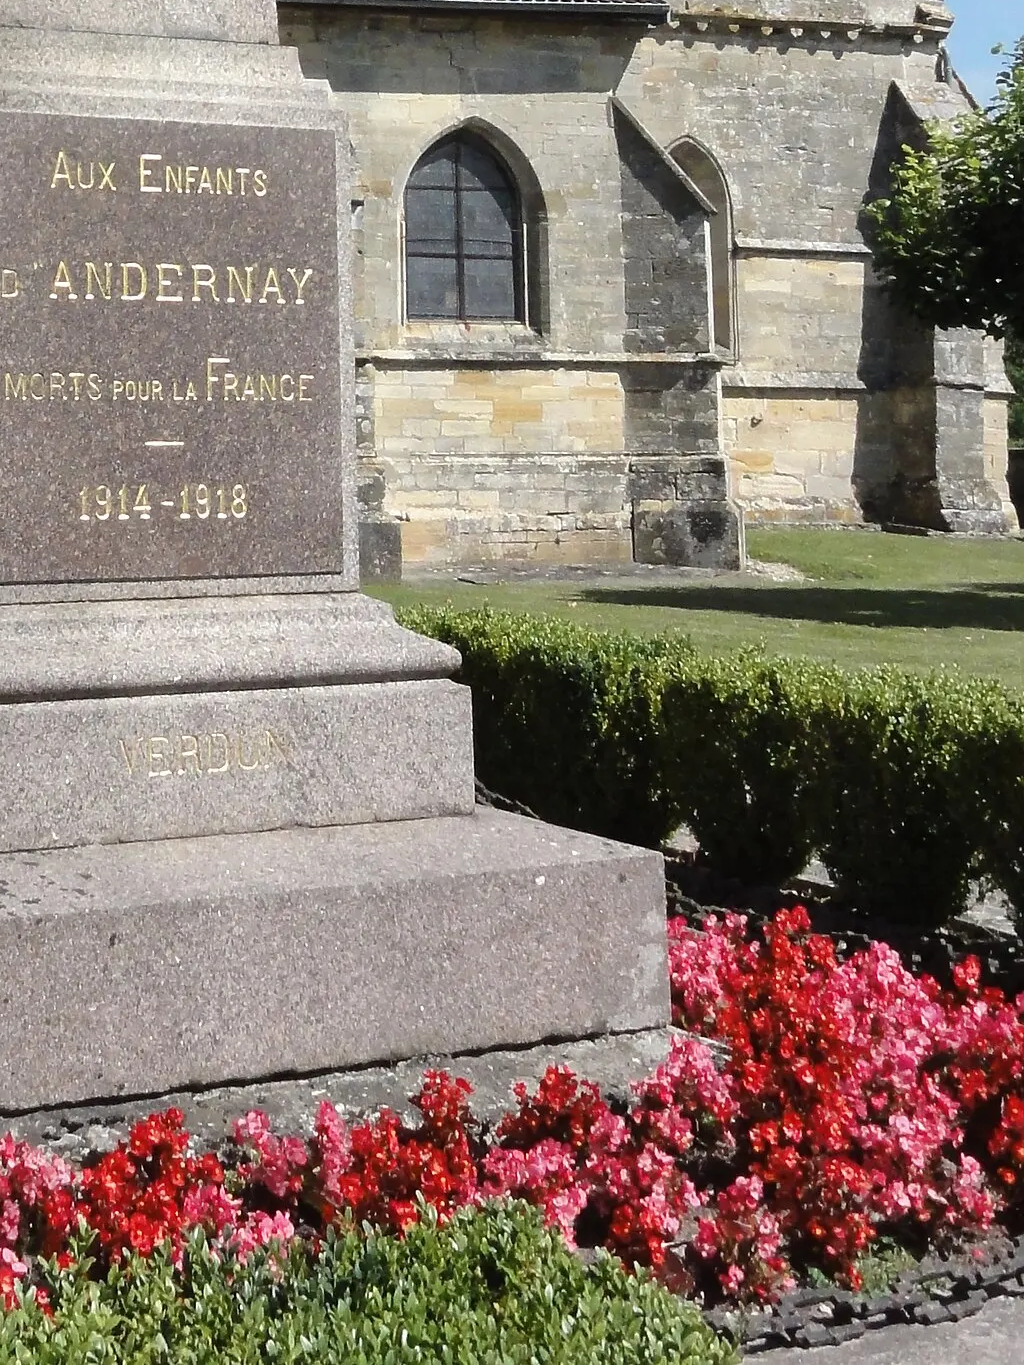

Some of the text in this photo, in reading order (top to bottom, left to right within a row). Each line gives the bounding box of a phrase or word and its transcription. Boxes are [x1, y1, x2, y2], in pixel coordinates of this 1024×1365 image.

[139, 154, 268, 197] ENFANTS
[5, 357, 314, 403] MORTS POUR LA FRANCE
[119, 729, 294, 778] VERDUN
